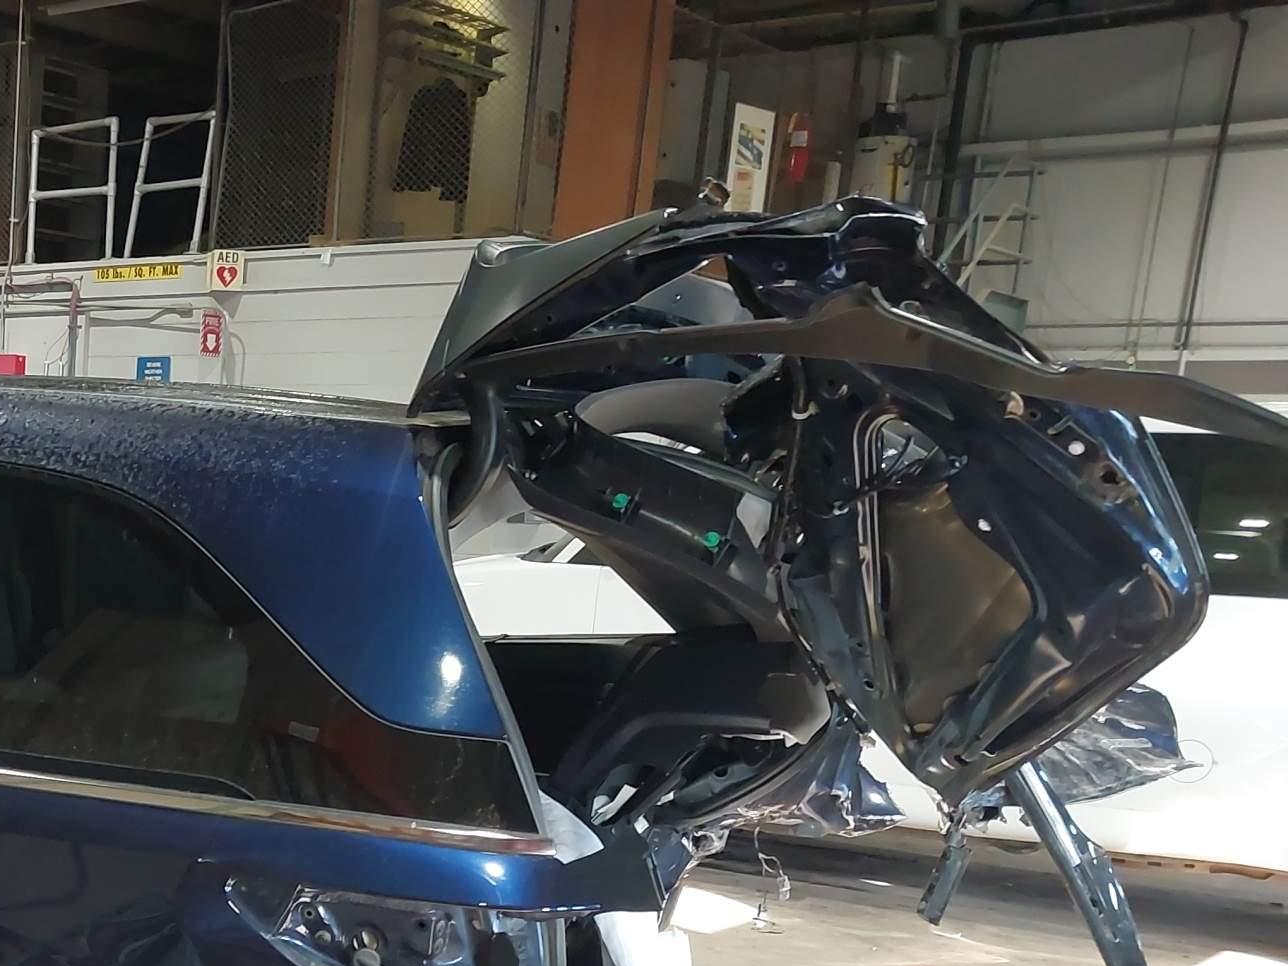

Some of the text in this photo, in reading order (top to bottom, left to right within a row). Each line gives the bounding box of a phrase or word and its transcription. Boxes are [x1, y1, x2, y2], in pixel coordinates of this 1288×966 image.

[217, 251, 239, 263] AED
[97, 268, 110, 280] 105
[134, 265, 146, 277] SQ.
[148, 266, 159, 277] FT.
[162, 263, 179, 276] MAX
